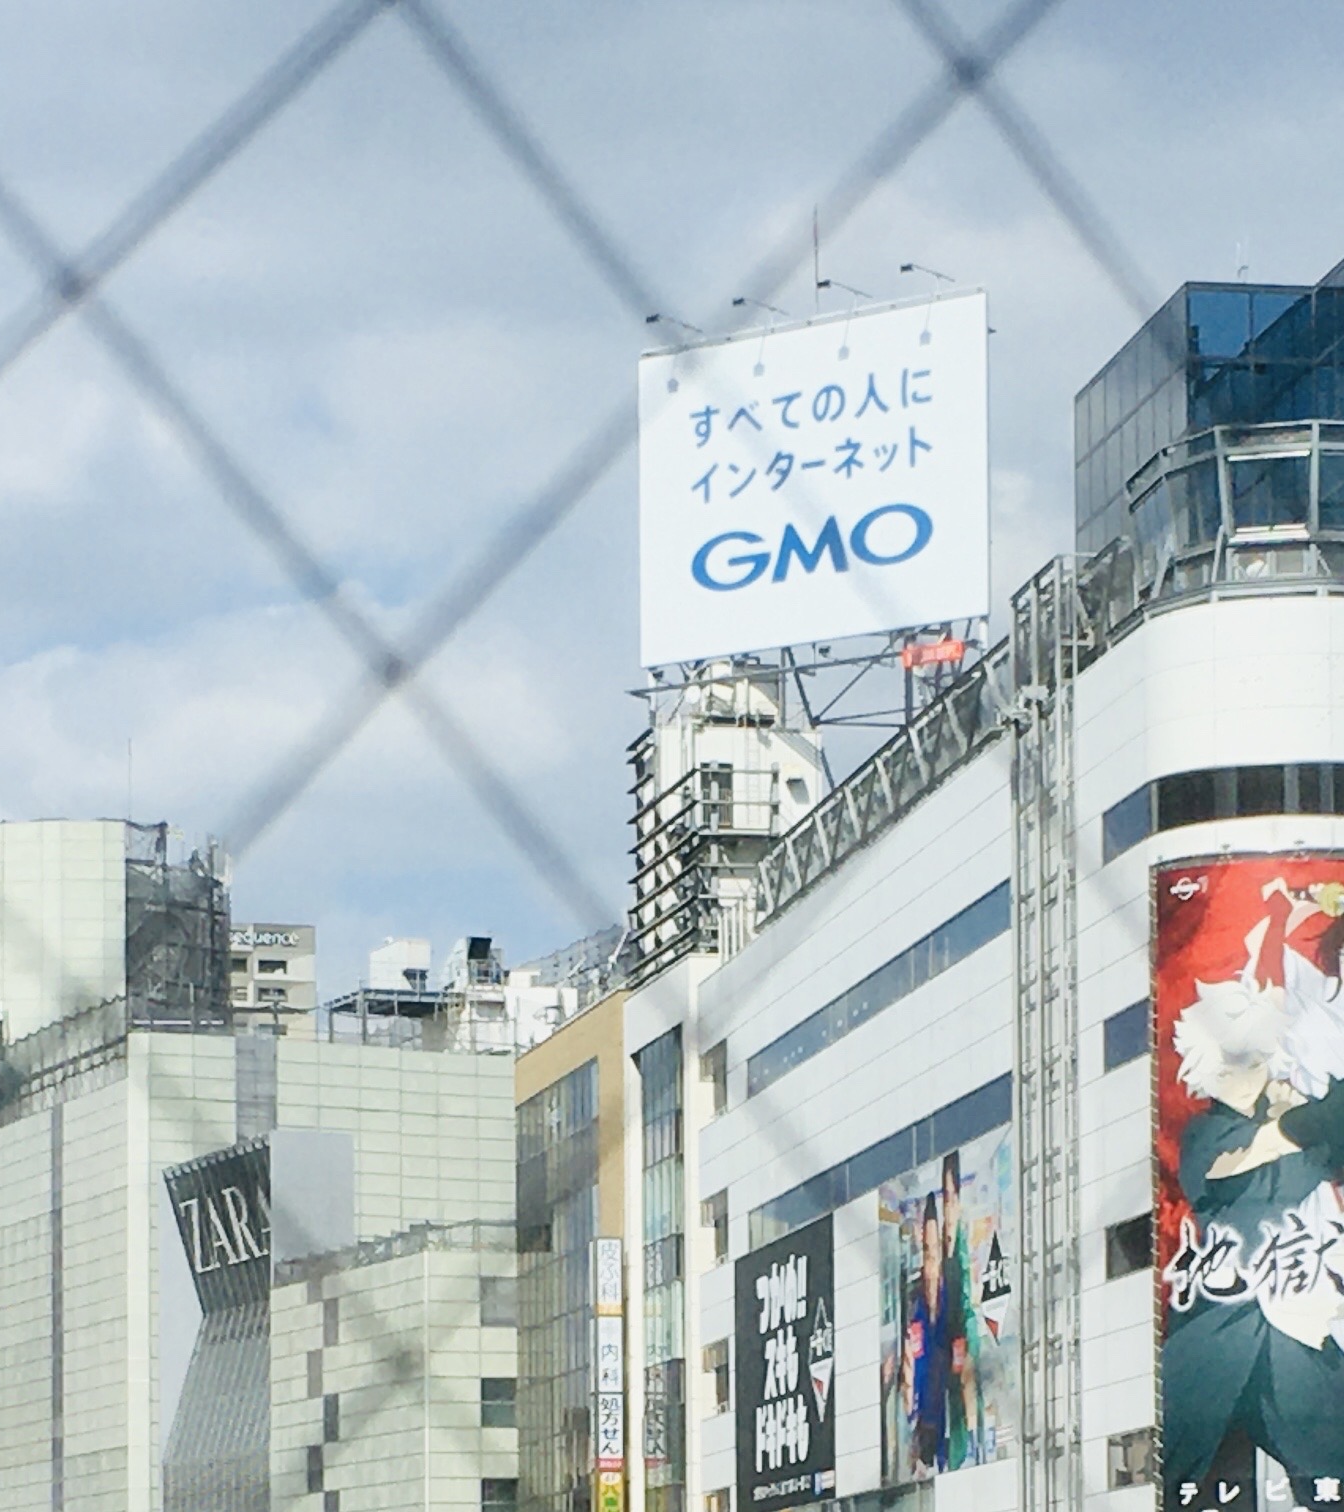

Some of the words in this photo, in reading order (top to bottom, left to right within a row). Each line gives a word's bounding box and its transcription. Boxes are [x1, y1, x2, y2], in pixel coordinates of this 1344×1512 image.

[690, 367, 933, 449] すべての人に
[690, 425, 933, 504] インターネット
[691, 503, 934, 592] GMO
